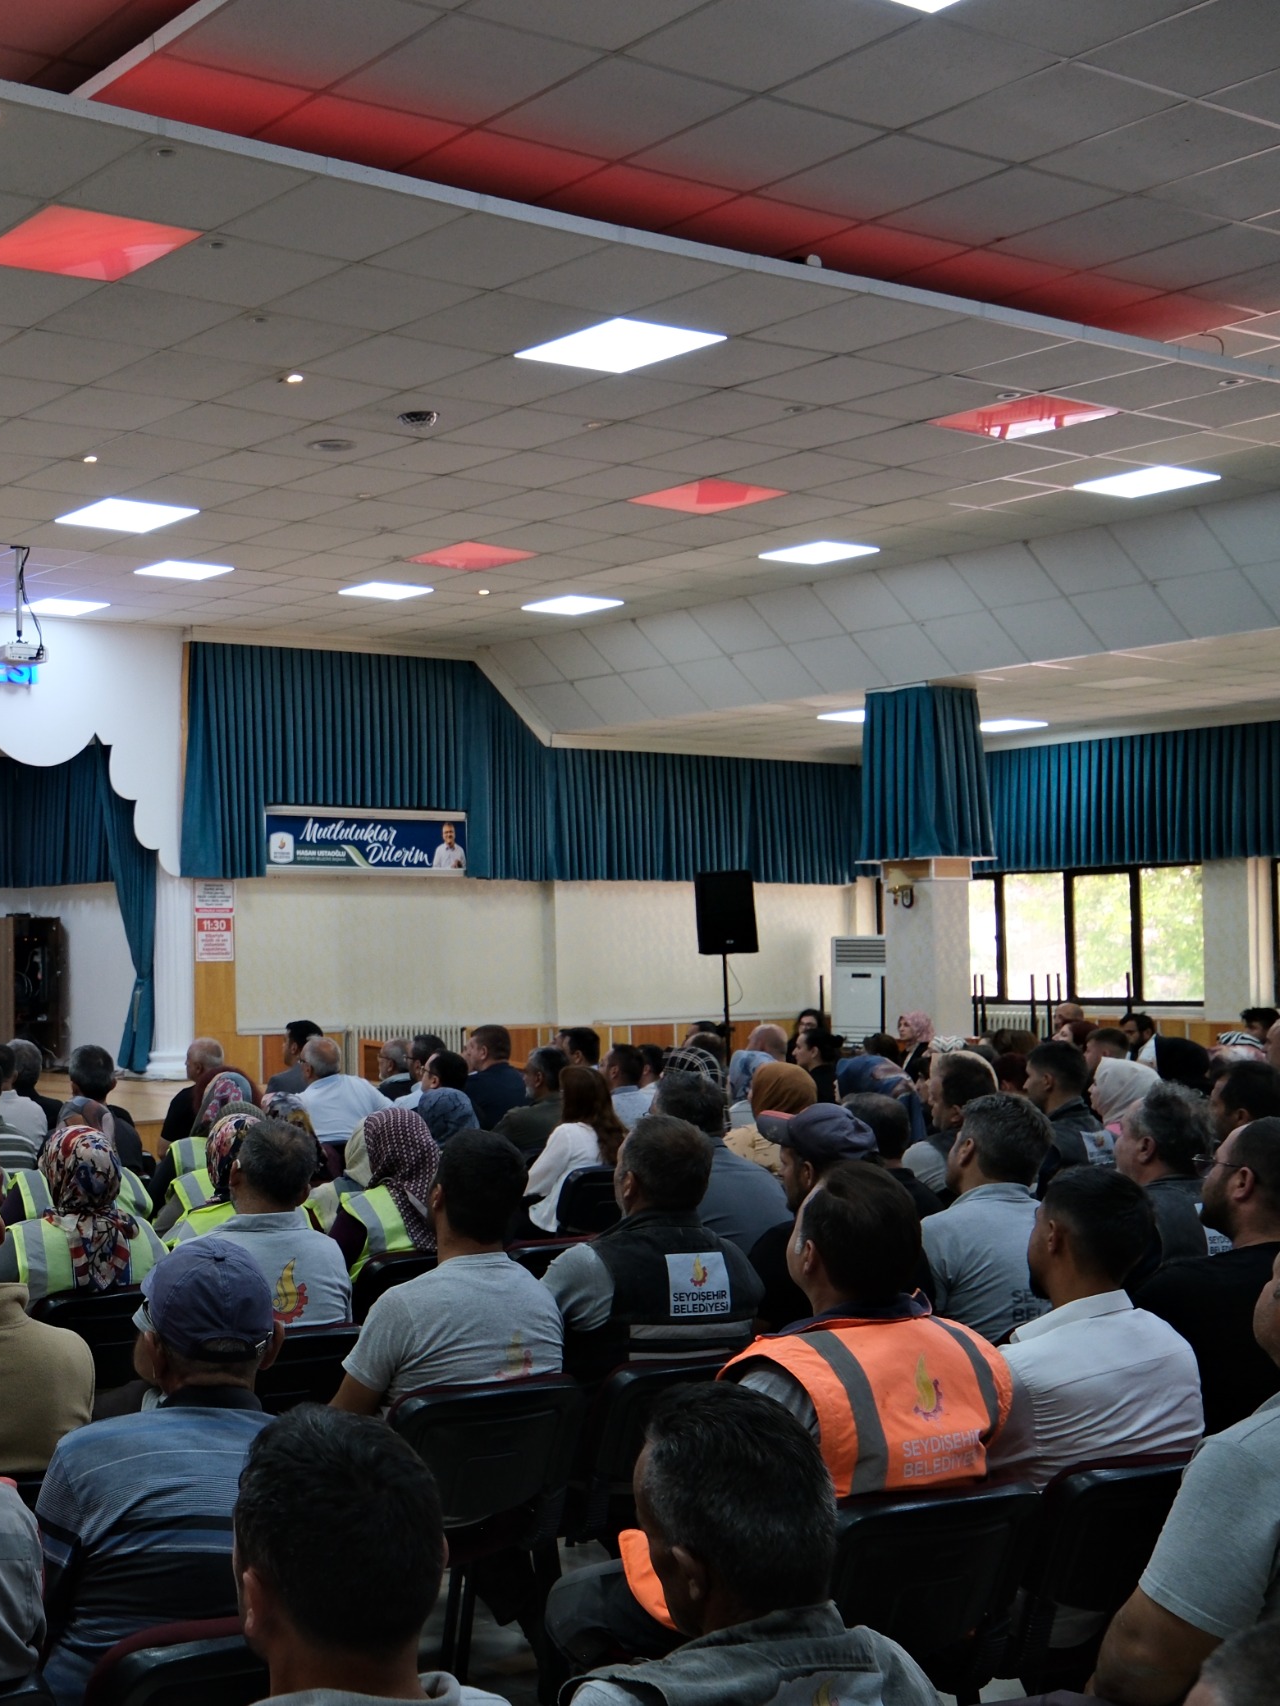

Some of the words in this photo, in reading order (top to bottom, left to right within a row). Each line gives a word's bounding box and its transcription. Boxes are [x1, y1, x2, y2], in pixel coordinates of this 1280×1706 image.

[299, 818, 397, 845] Mutluluklar
[366, 842, 433, 867] Dilerim
[202, 919, 226, 931] 11:30
[672, 1290, 727, 1302] SEYDİŞEHİR
[673, 1302, 729, 1314] BELEDİYESİ
